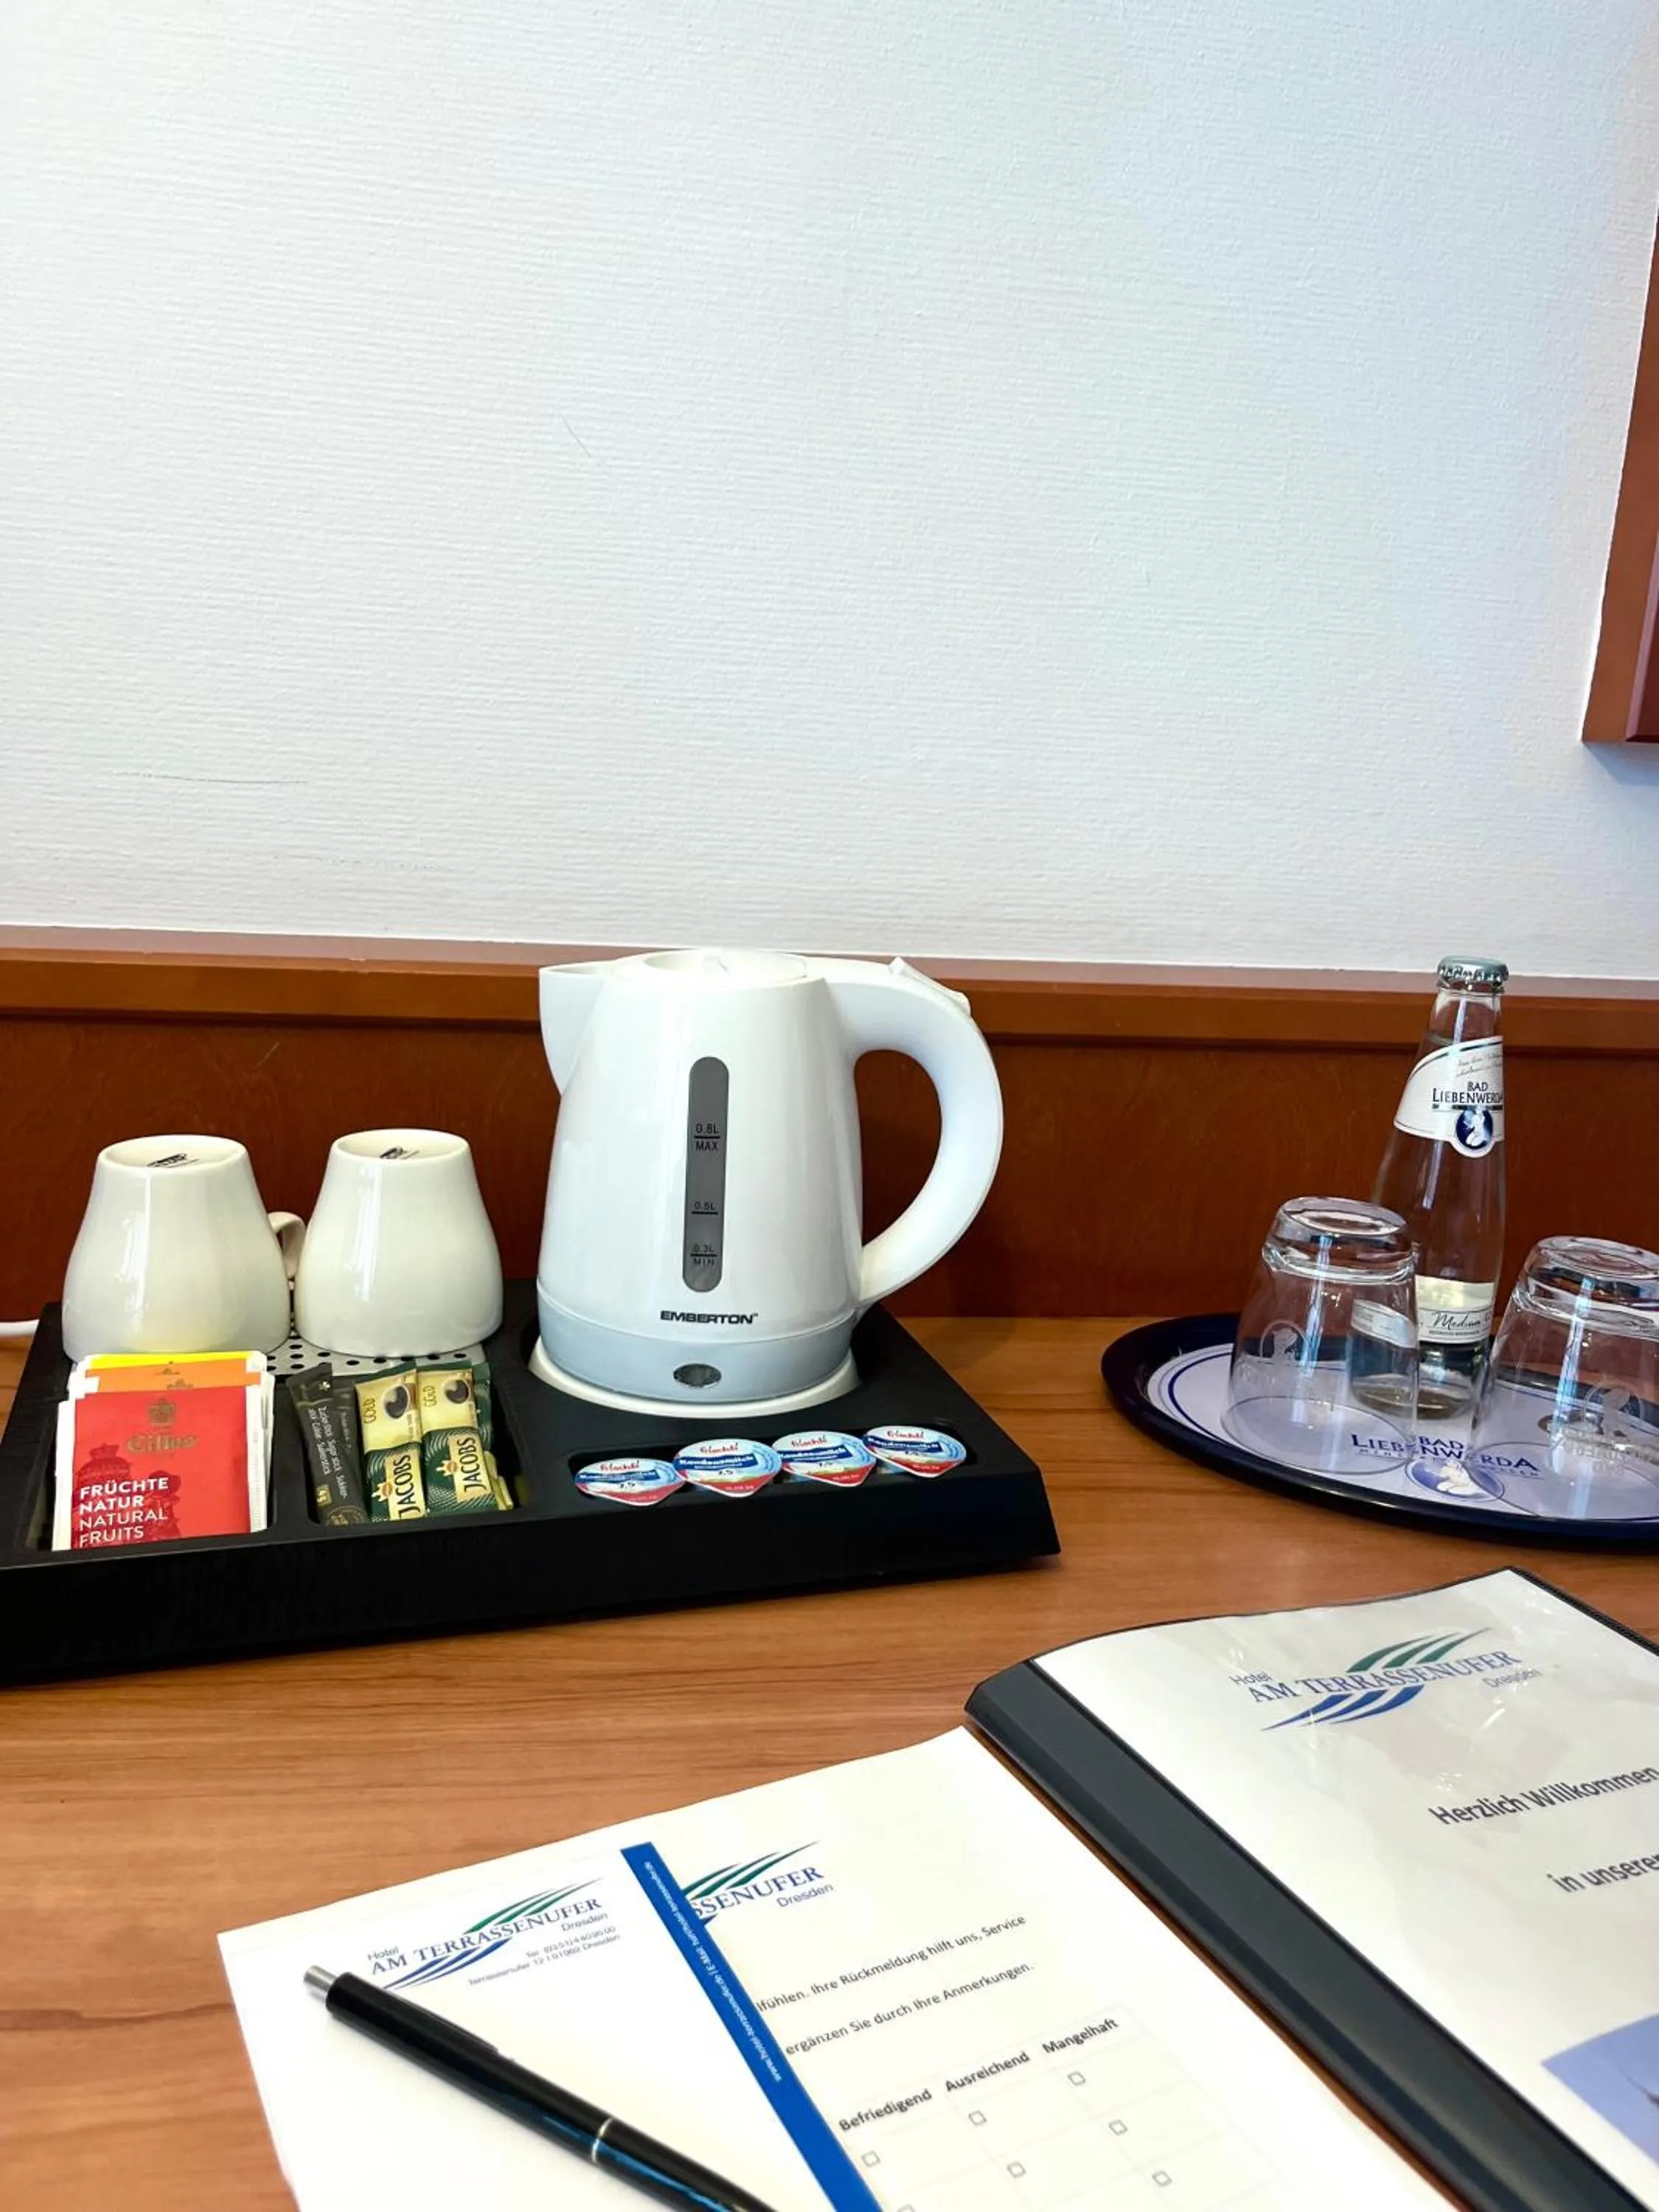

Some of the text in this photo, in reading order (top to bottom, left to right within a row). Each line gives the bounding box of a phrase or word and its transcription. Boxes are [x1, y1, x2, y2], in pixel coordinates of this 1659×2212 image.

[1467, 1081, 1488, 1091] BAD
[695, 1141, 718, 1151] MAX
[693, 1257, 714, 1266] MIN
[1419, 1436, 1464, 1450] BAD
[457, 1438, 487, 1493] JACOBS
[80, 1477, 169, 1500] FRÜCHTE
[393, 1455, 420, 1519] JACOBS
[79, 1495, 144, 1516] NATUR
[79, 1506, 169, 1531] NATURAL
[79, 1526, 144, 1548] FRUITS
[1248, 1651, 1523, 1703] AM TERRASSENUFER
[1428, 1767, 1659, 1825] Herzlich Willkommen
[776, 1883, 837, 1908] Dresden
[1547, 1873, 1586, 1893] in
[561, 1912, 609, 1932] Dresden
[372, 1898, 602, 1975] AM TERRASSENUFER
[810, 1980, 838, 1995] Ihre
[839, 1950, 928, 1985] Rückmeldung
[926, 1939, 955, 1955] hilft
[981, 1916, 1026, 1937] Service
[785, 1963, 1034, 2055] ergänzen Sie durch Ihre Anmerkungen.
[838, 2017, 1119, 2132] Befriedigend Ausreichend Mangelhaft
